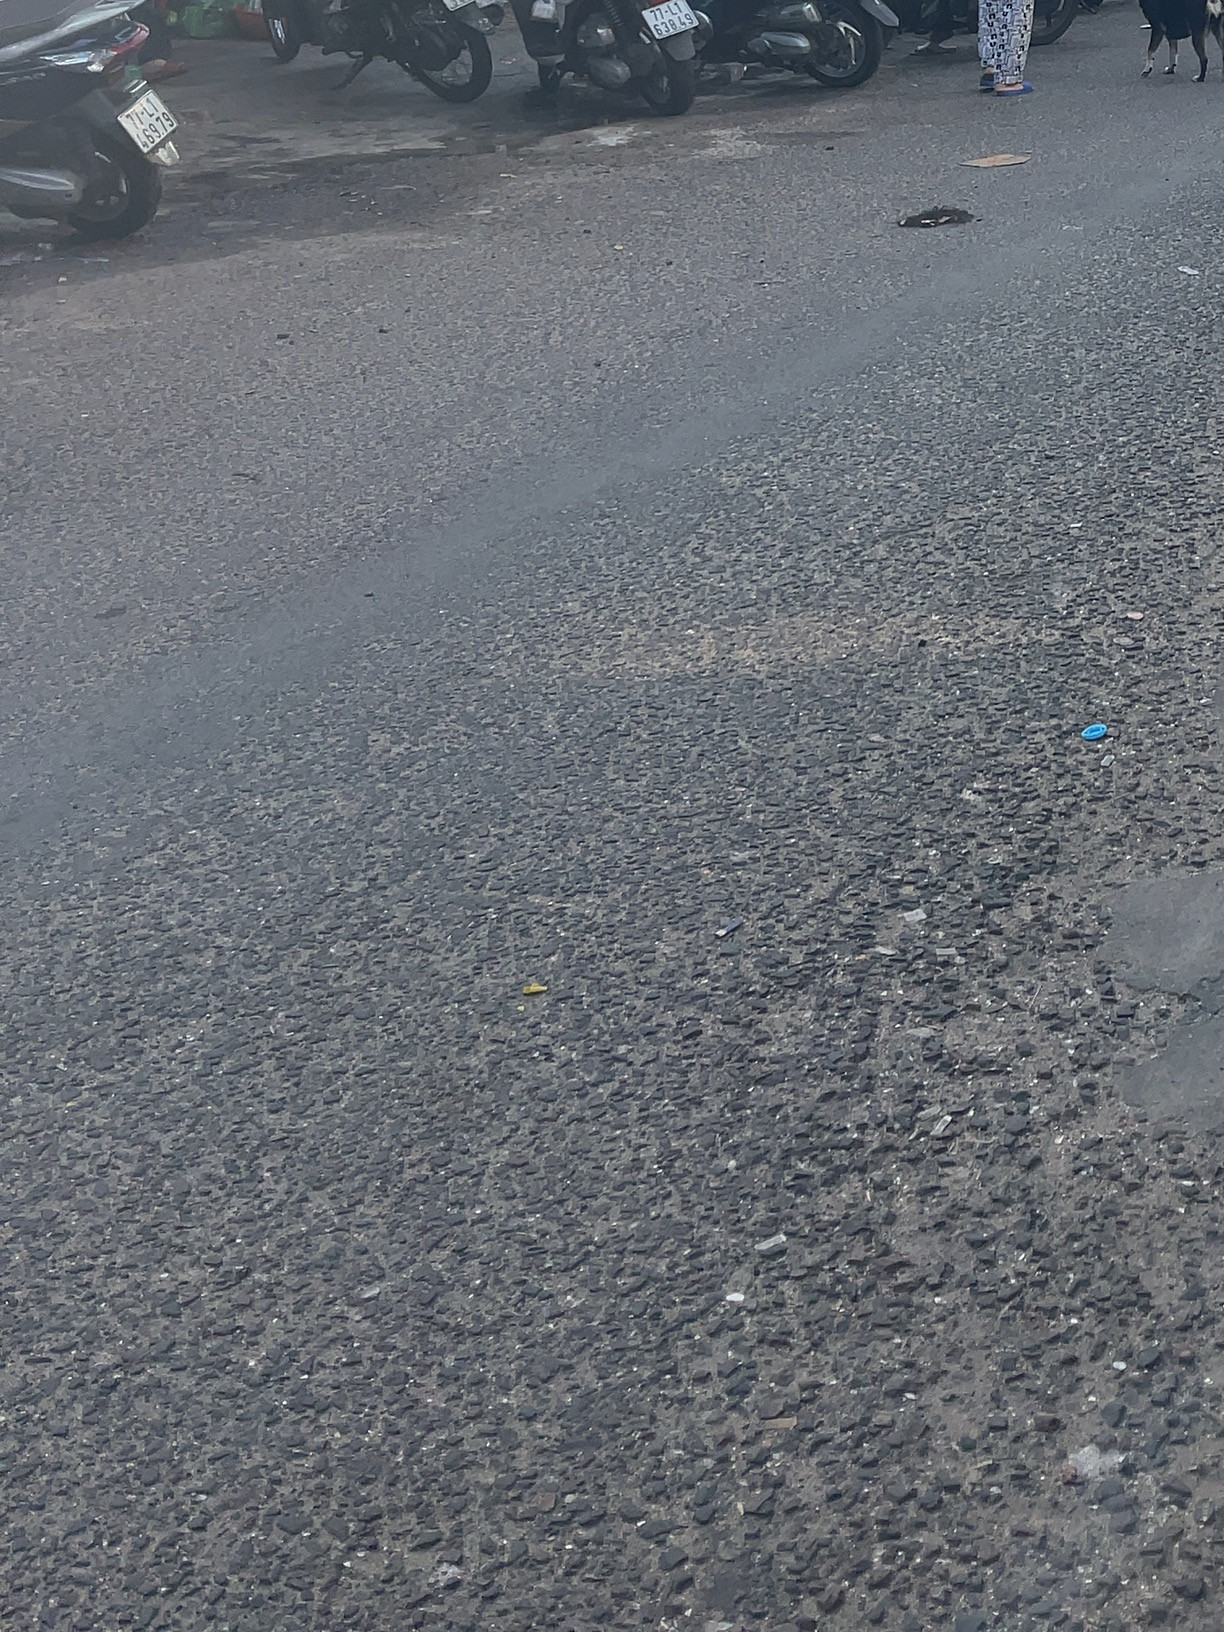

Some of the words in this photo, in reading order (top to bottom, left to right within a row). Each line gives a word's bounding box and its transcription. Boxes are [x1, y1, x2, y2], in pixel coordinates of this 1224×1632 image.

[649, 2, 683, 22] 77-L1
[125, 97, 159, 130] 77-L1
[136, 111, 175, 149] 469.79
